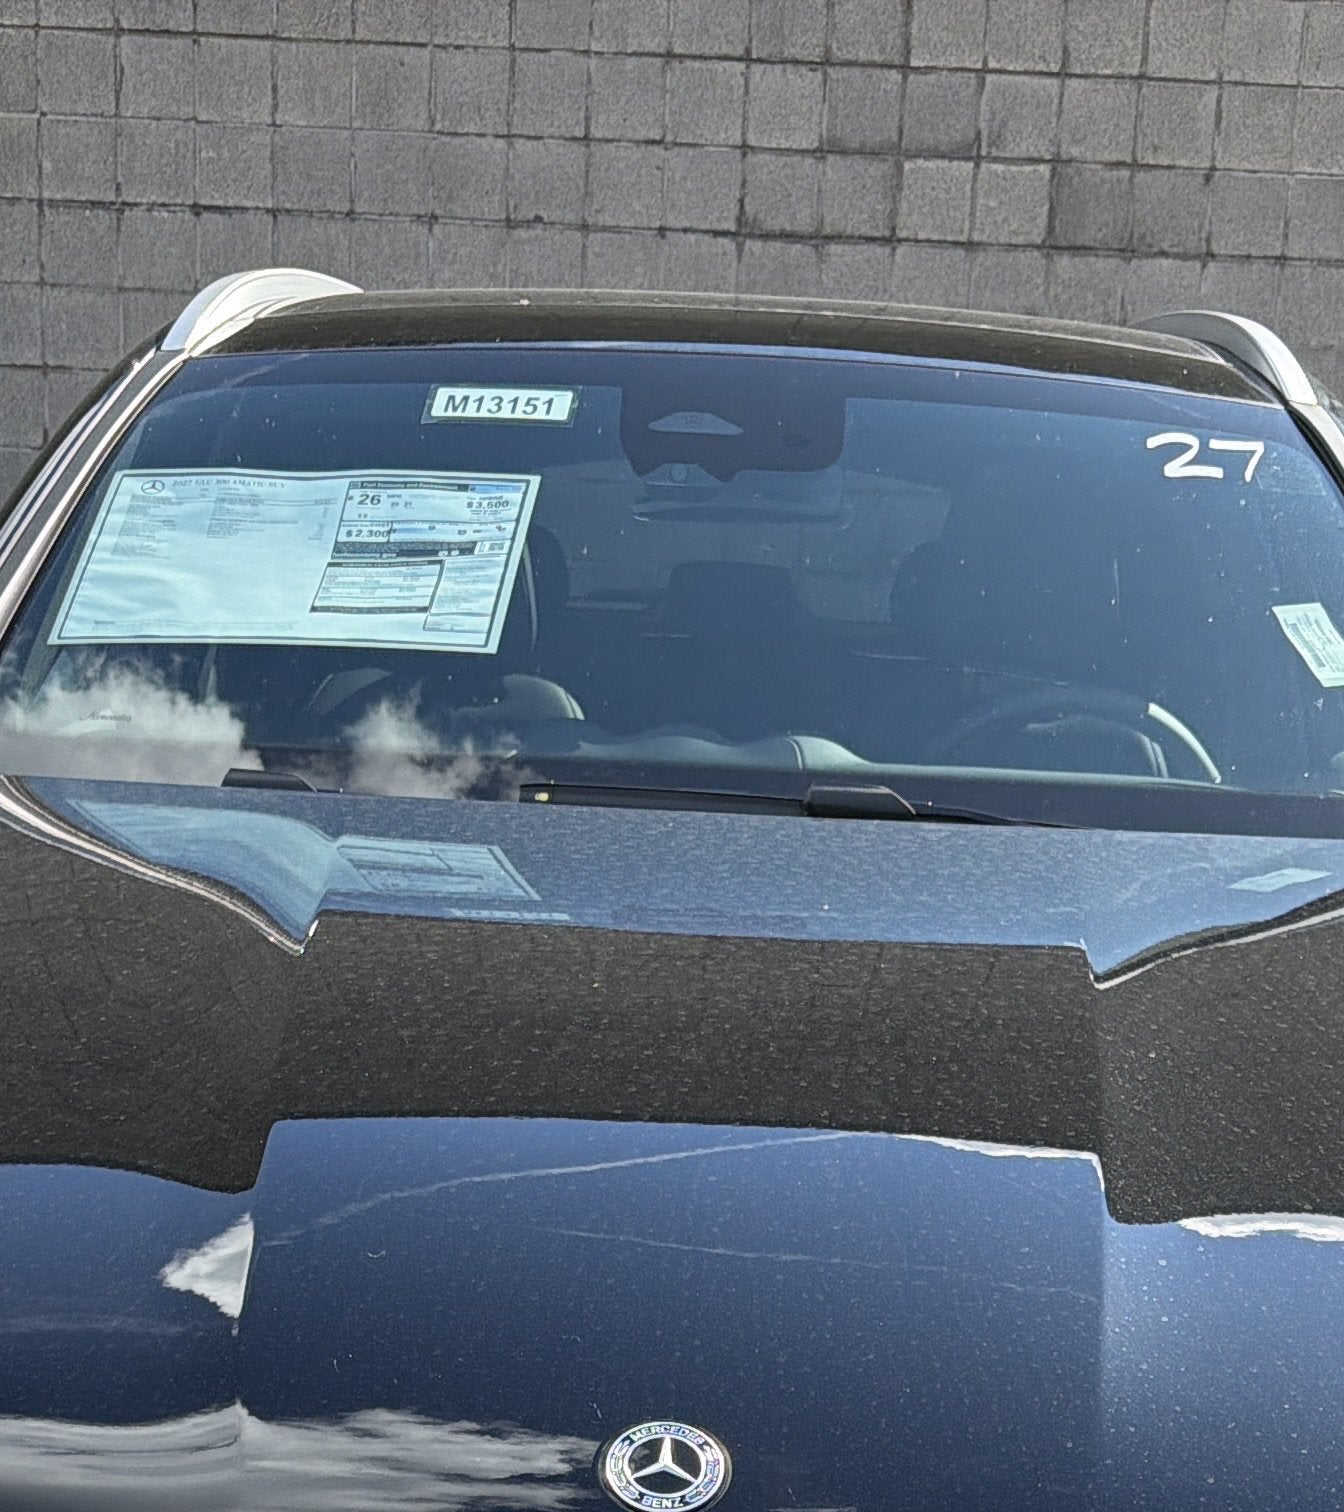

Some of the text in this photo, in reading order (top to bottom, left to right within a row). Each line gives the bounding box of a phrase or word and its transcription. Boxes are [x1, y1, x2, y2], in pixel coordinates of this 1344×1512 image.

[442, 394, 556, 417] M13151
[1146, 432, 1265, 483] 27
[357, 493, 382, 506] 26
[629, 1424, 706, 1446] MERCEDES
[641, 1495, 685, 1510] BENZ
